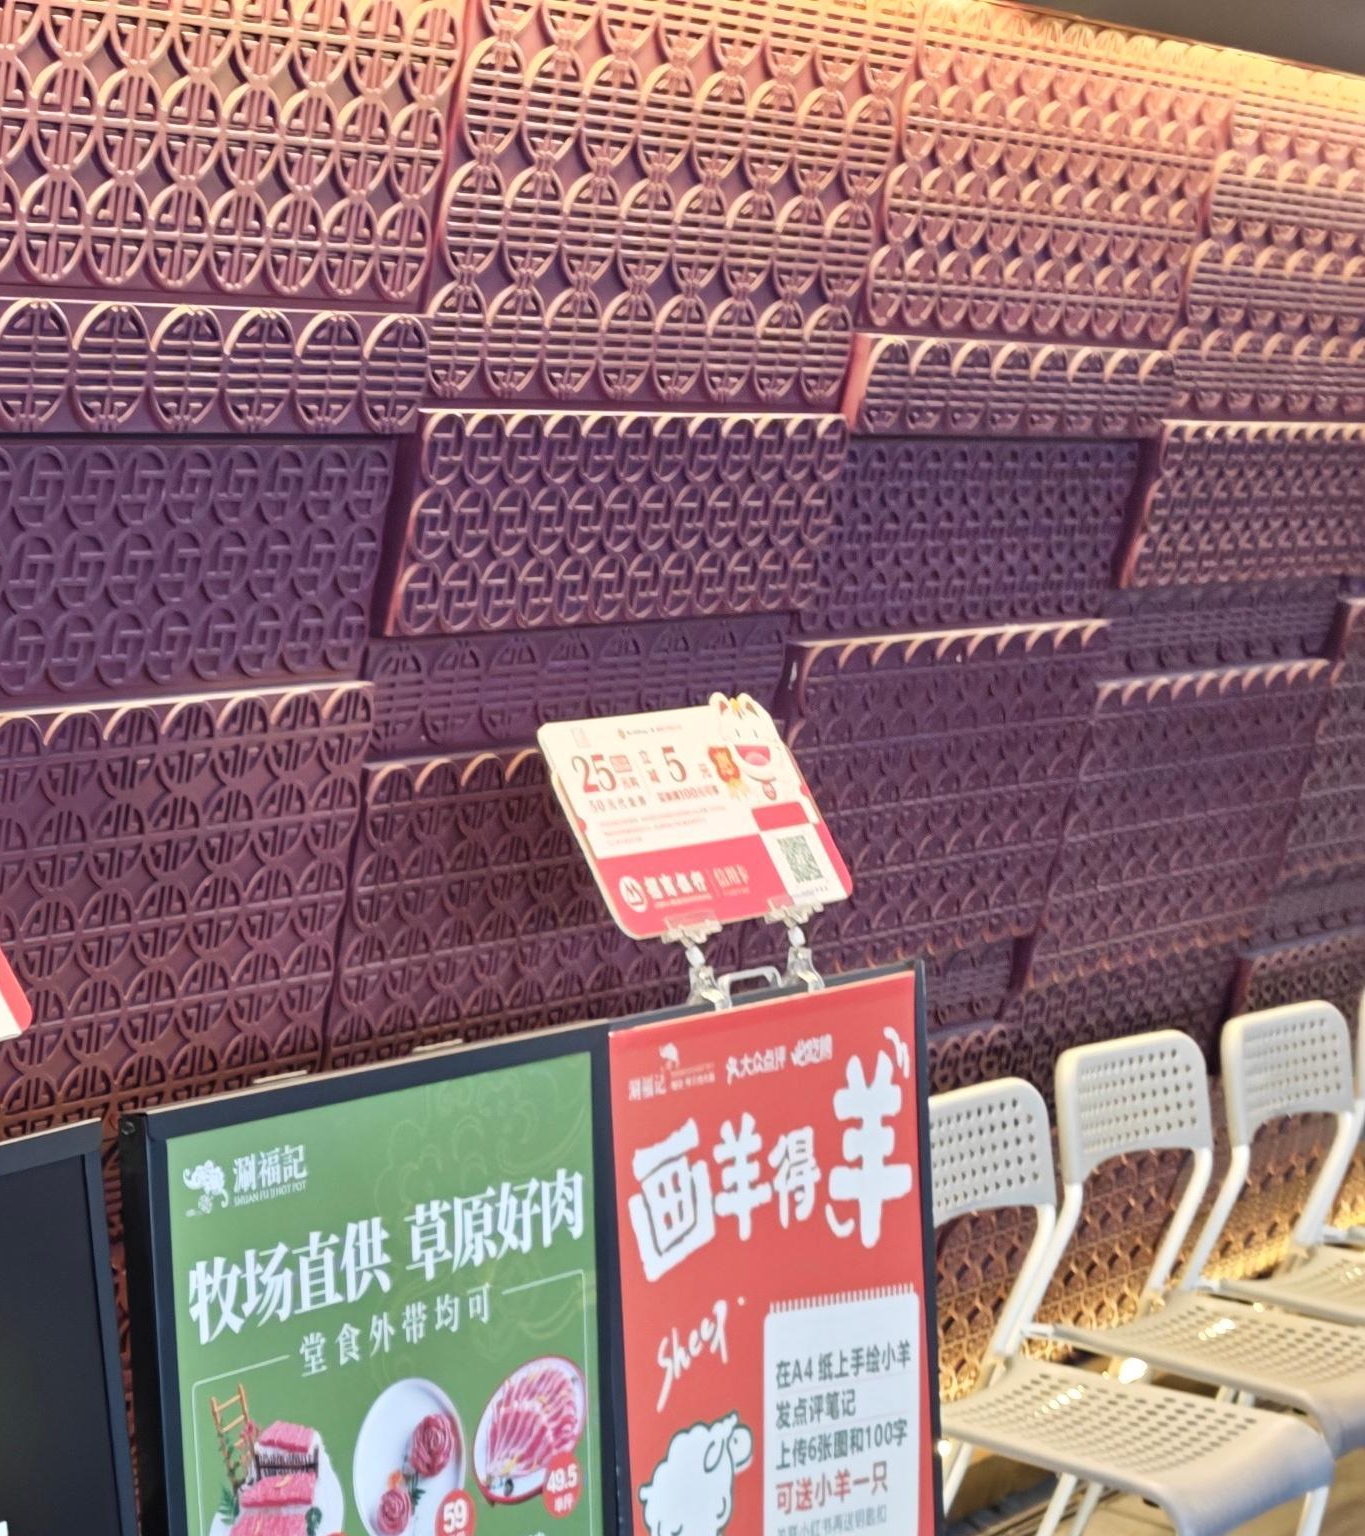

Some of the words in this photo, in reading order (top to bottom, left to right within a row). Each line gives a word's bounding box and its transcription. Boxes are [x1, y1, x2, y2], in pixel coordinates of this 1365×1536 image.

[572, 754, 616, 793] 25
[662, 746, 687, 783] 5
[232, 1145, 308, 1193] 涮福記
[188, 1216, 392, 1346] 牧场直供
[403, 1168, 585, 1282] 草原好肉
[299, 1283, 492, 1378] 堂食外带均可
[776, 1389, 856, 1430] 发点评笔记
[776, 1419, 908, 1470] 上传6张图和100字
[546, 1467, 579, 1496] 49.5
[776, 1461, 888, 1515] 可送小羊一只
[443, 1498, 468, 1534] 59
